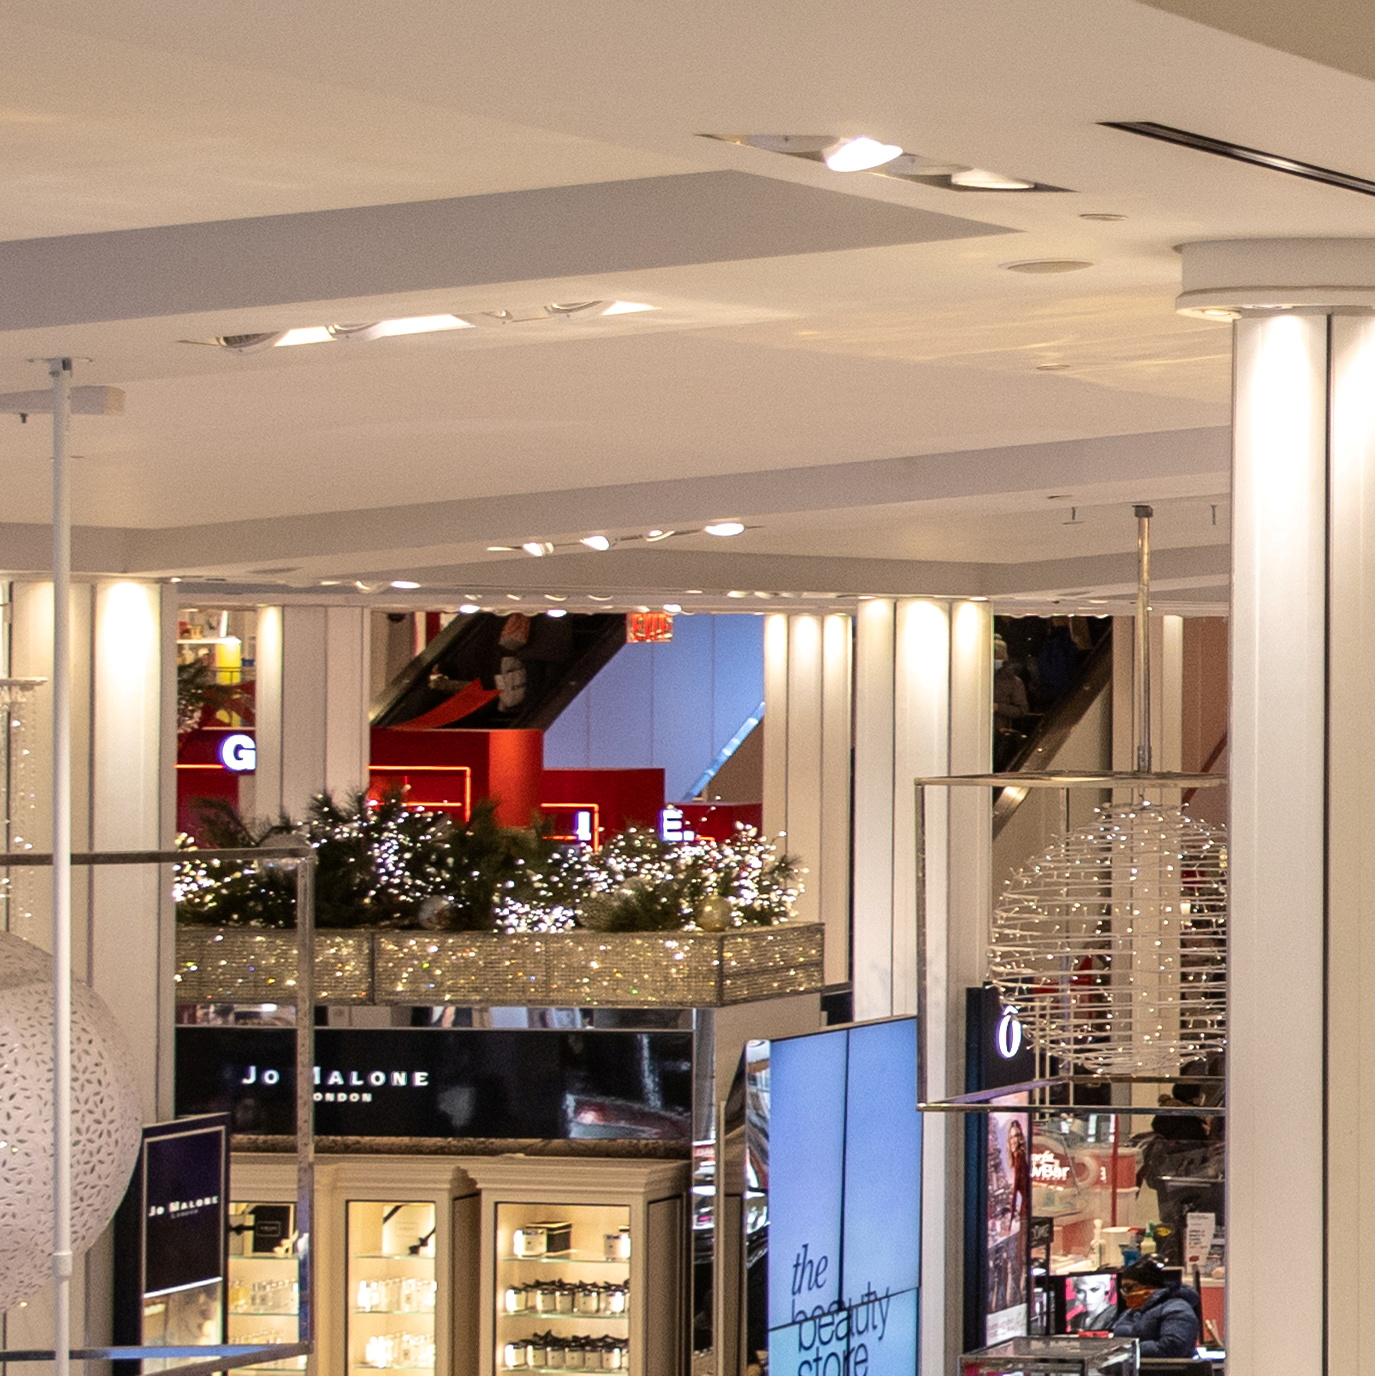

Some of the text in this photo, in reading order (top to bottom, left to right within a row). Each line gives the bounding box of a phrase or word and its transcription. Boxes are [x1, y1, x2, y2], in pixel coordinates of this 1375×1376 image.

[313, 1092, 372, 1103] ONDON
[169, 1195, 219, 1212] MALONE
[791, 1243, 829, 1297] the
[791, 1282, 891, 1352] beauty
